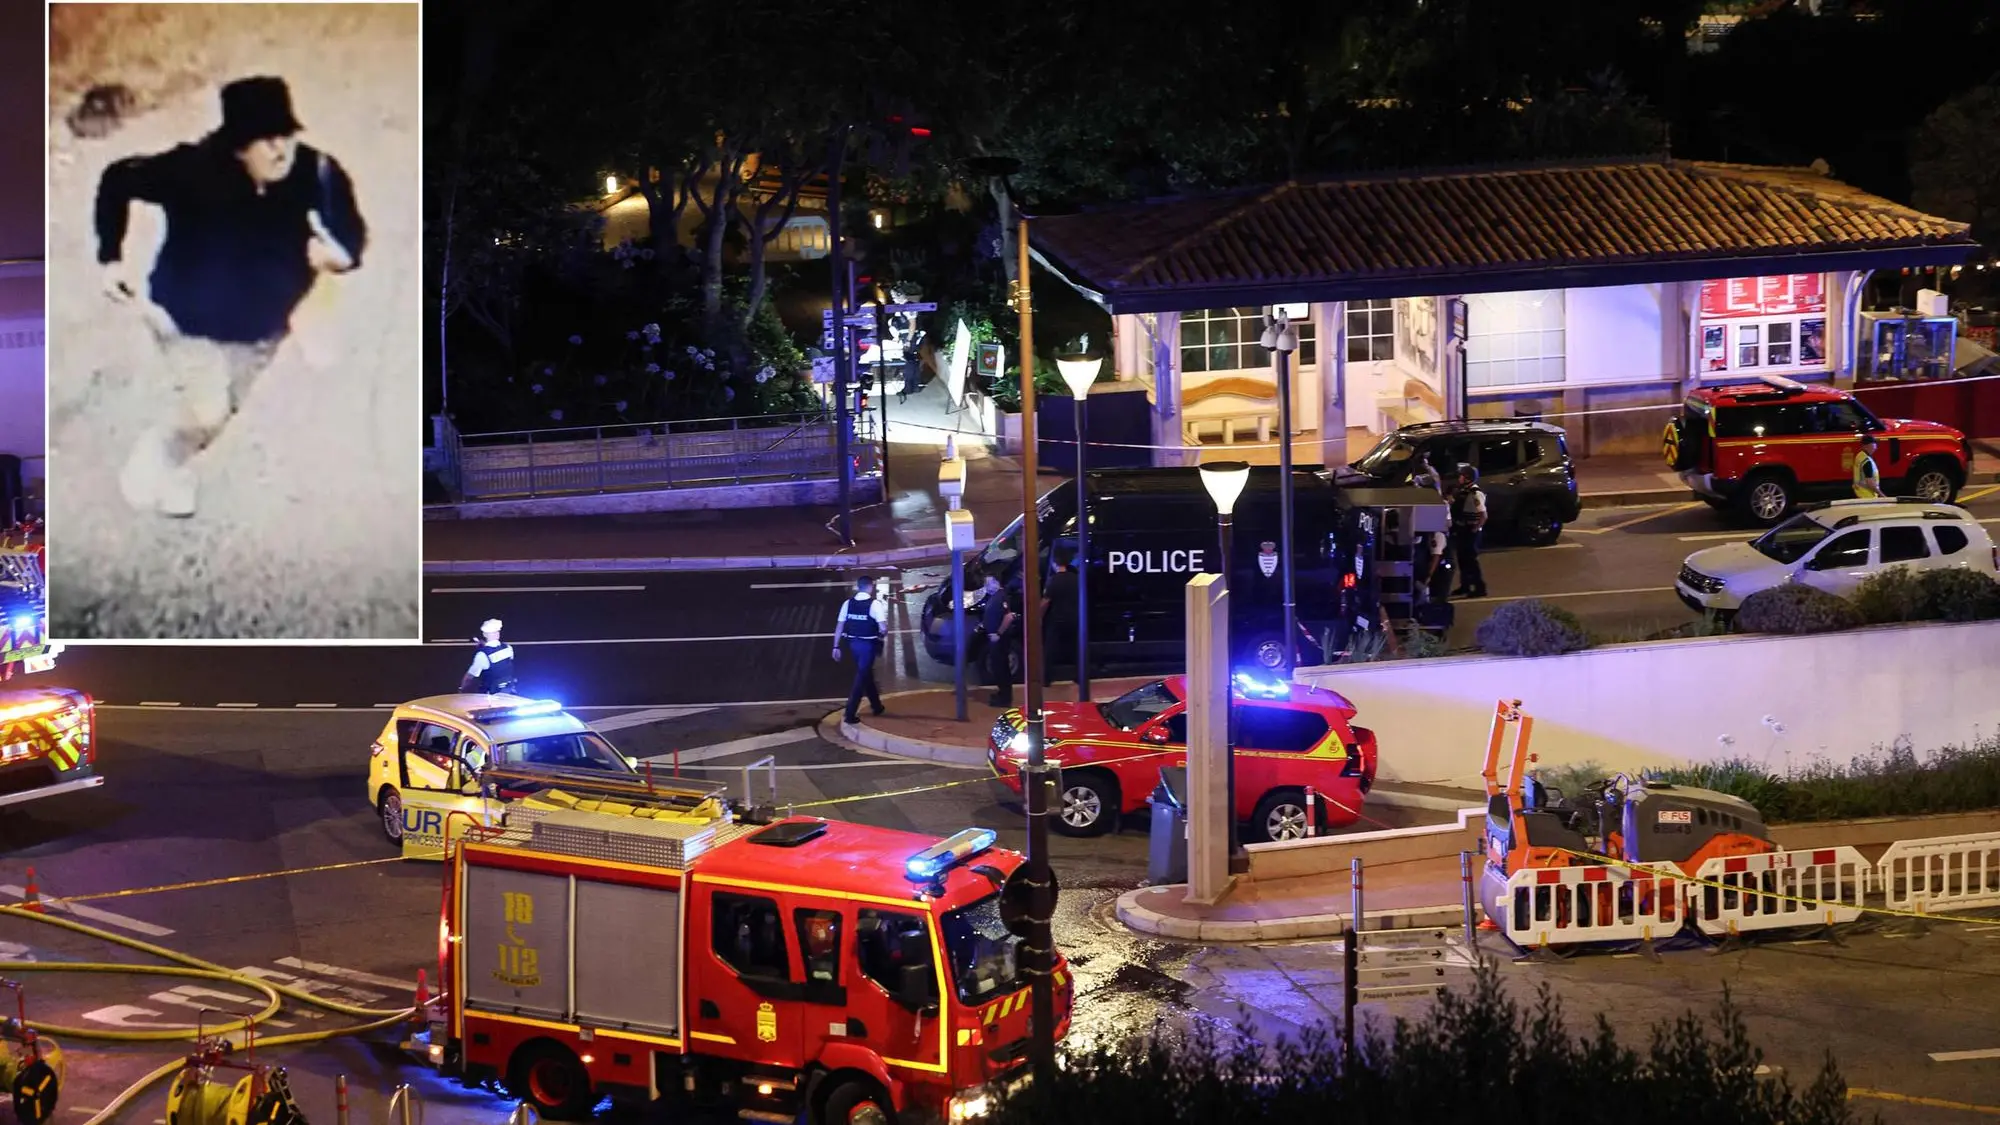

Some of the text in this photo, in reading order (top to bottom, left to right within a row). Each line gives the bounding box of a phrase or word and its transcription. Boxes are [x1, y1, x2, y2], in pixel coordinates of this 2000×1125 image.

[1108, 549, 1205, 574] POLICE
[403, 808, 442, 834] UR
[501, 891, 533, 924] 18
[498, 944, 538, 976] 112
